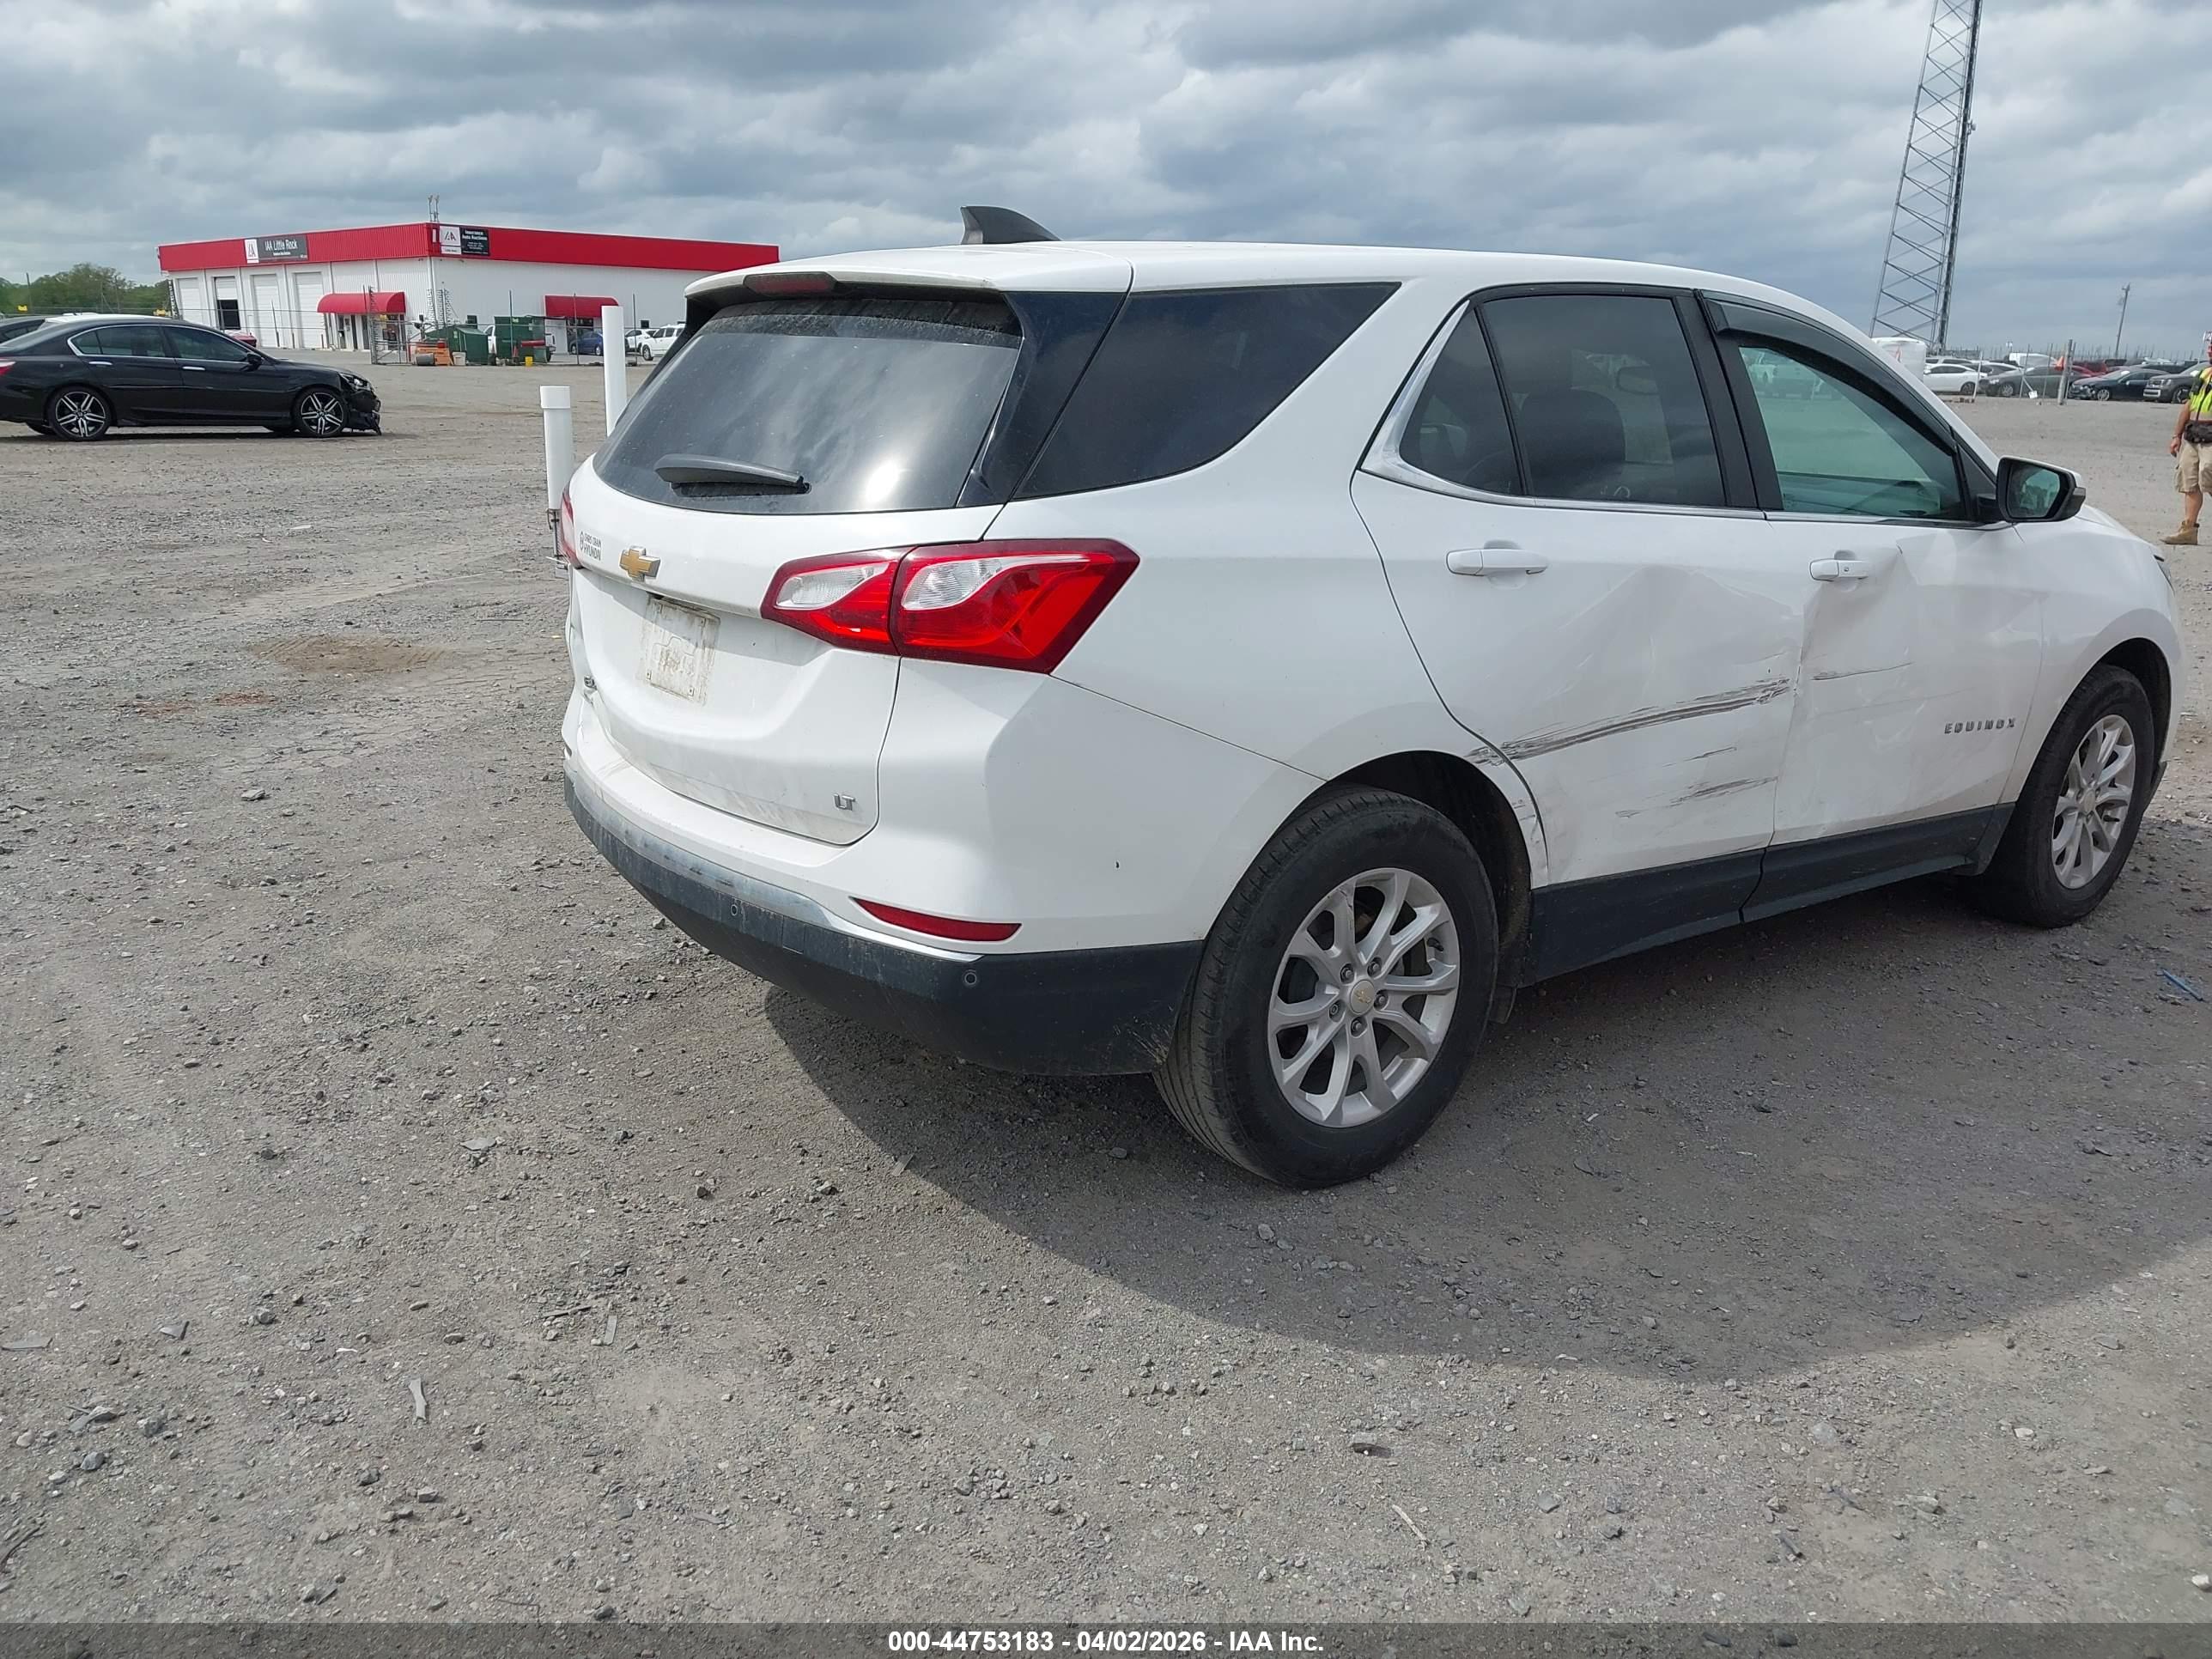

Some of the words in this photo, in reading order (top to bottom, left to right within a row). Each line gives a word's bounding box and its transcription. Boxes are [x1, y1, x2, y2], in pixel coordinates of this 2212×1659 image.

[264, 240, 273, 251] IAA
[273, 240, 285, 250] Little
[285, 239, 298, 250] Rock
[583, 544, 601, 560] HYUNDAI
[1944, 717, 2016, 734] EQUINOX
[833, 793, 856, 811] LT
